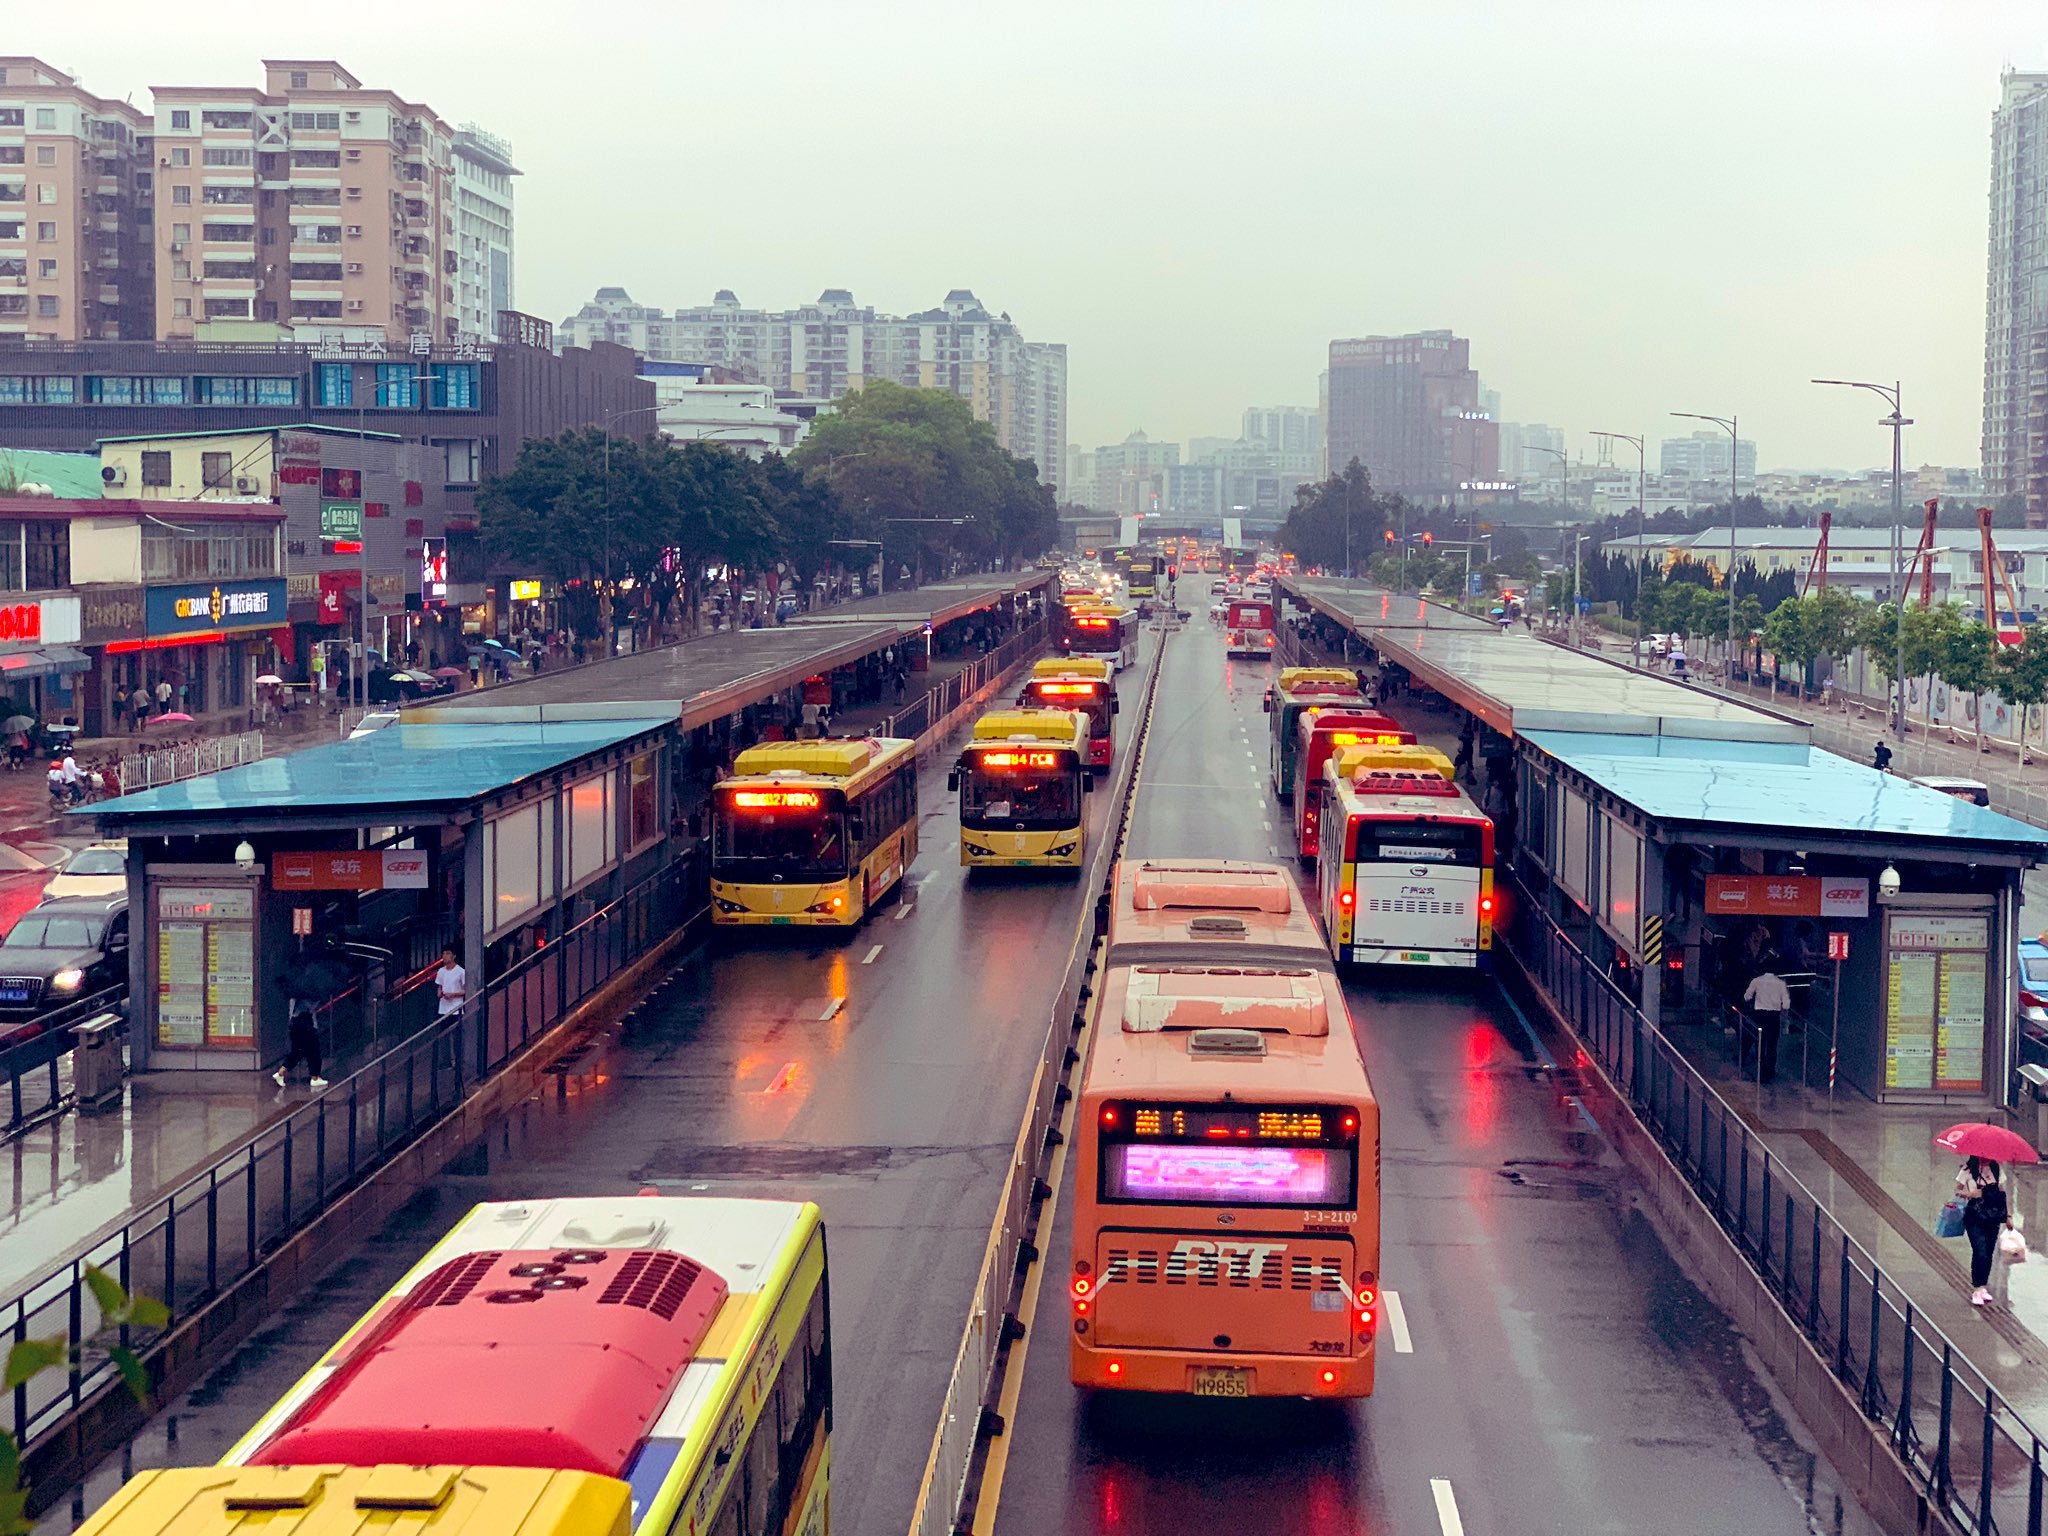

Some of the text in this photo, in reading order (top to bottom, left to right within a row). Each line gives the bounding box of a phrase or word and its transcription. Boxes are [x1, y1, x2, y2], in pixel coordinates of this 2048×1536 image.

[175, 592, 268, 617] GRCBANK 广州农商银行
[331, 859, 361, 874] 棠东
[1401, 886, 1435, 895] 广州公交
[1767, 884, 1799, 900] 棠东
[1303, 1211, 1358, 1223] 3-3-2109
[1164, 1240, 1288, 1278] BRT
[1196, 1378, 1246, 1395] H9855
